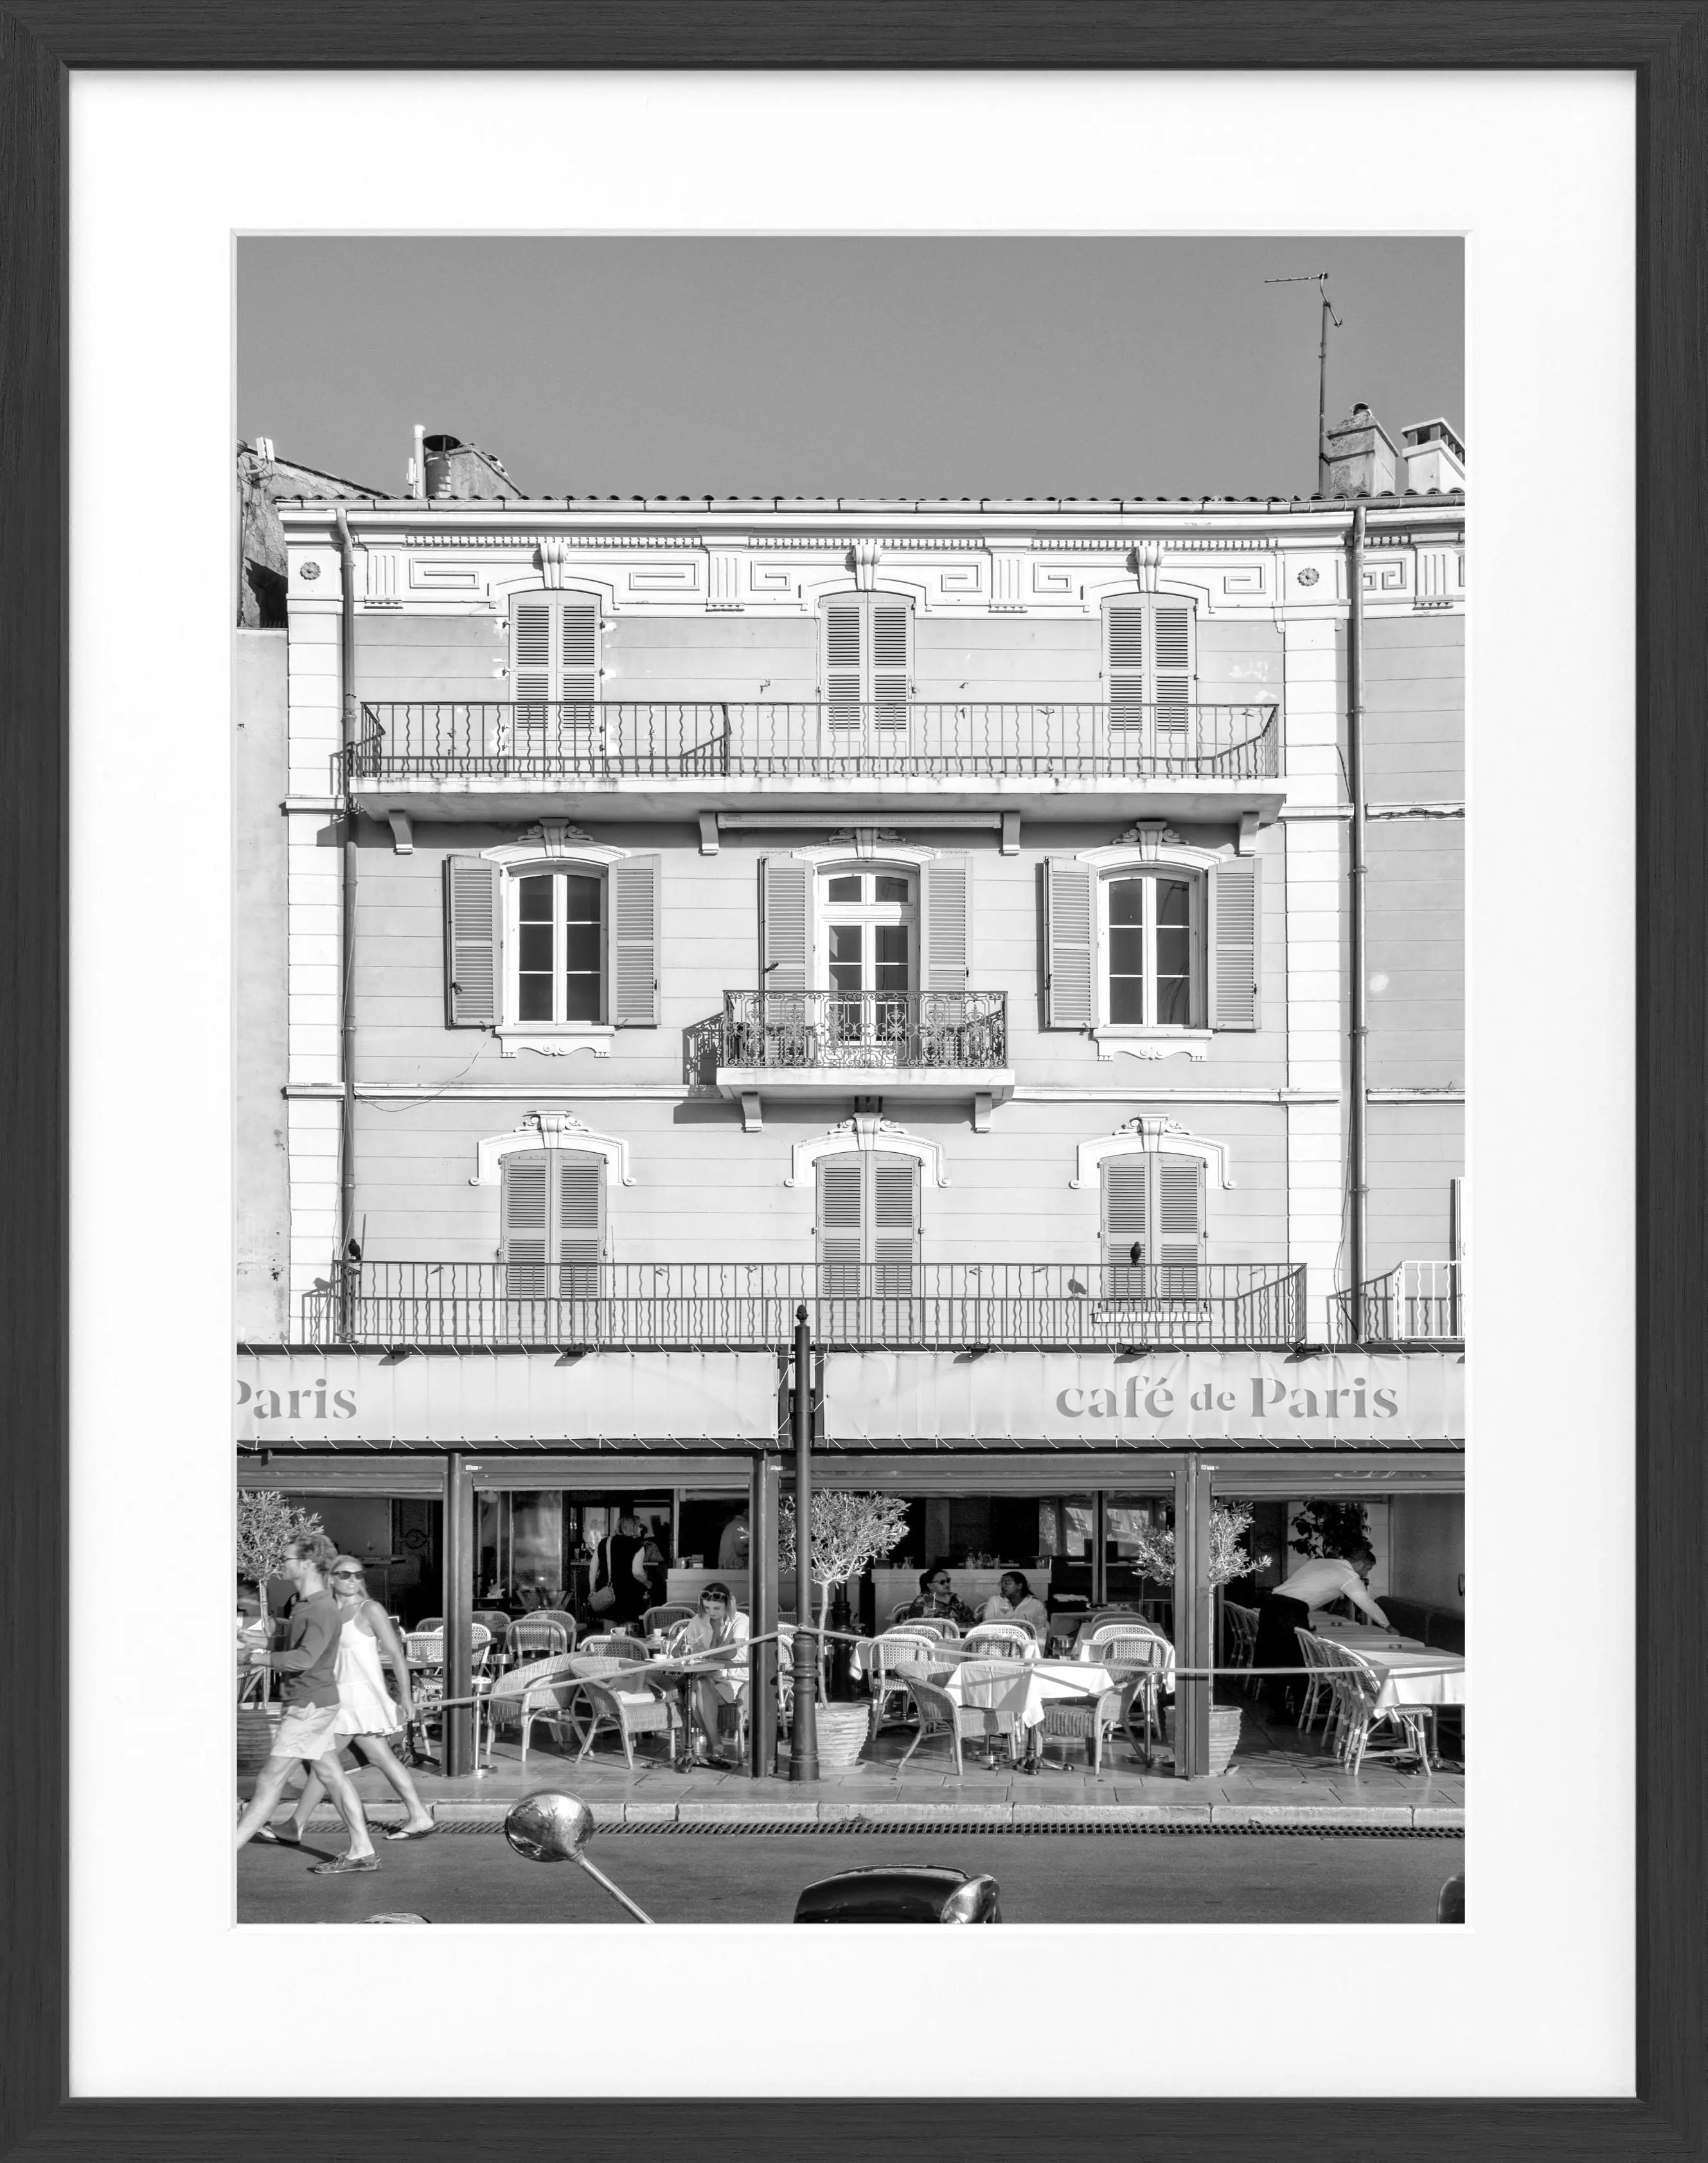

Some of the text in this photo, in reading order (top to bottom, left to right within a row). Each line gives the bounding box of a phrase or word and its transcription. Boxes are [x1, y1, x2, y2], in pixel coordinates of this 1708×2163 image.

[1056, 1375, 1398, 1418] café de Paris
